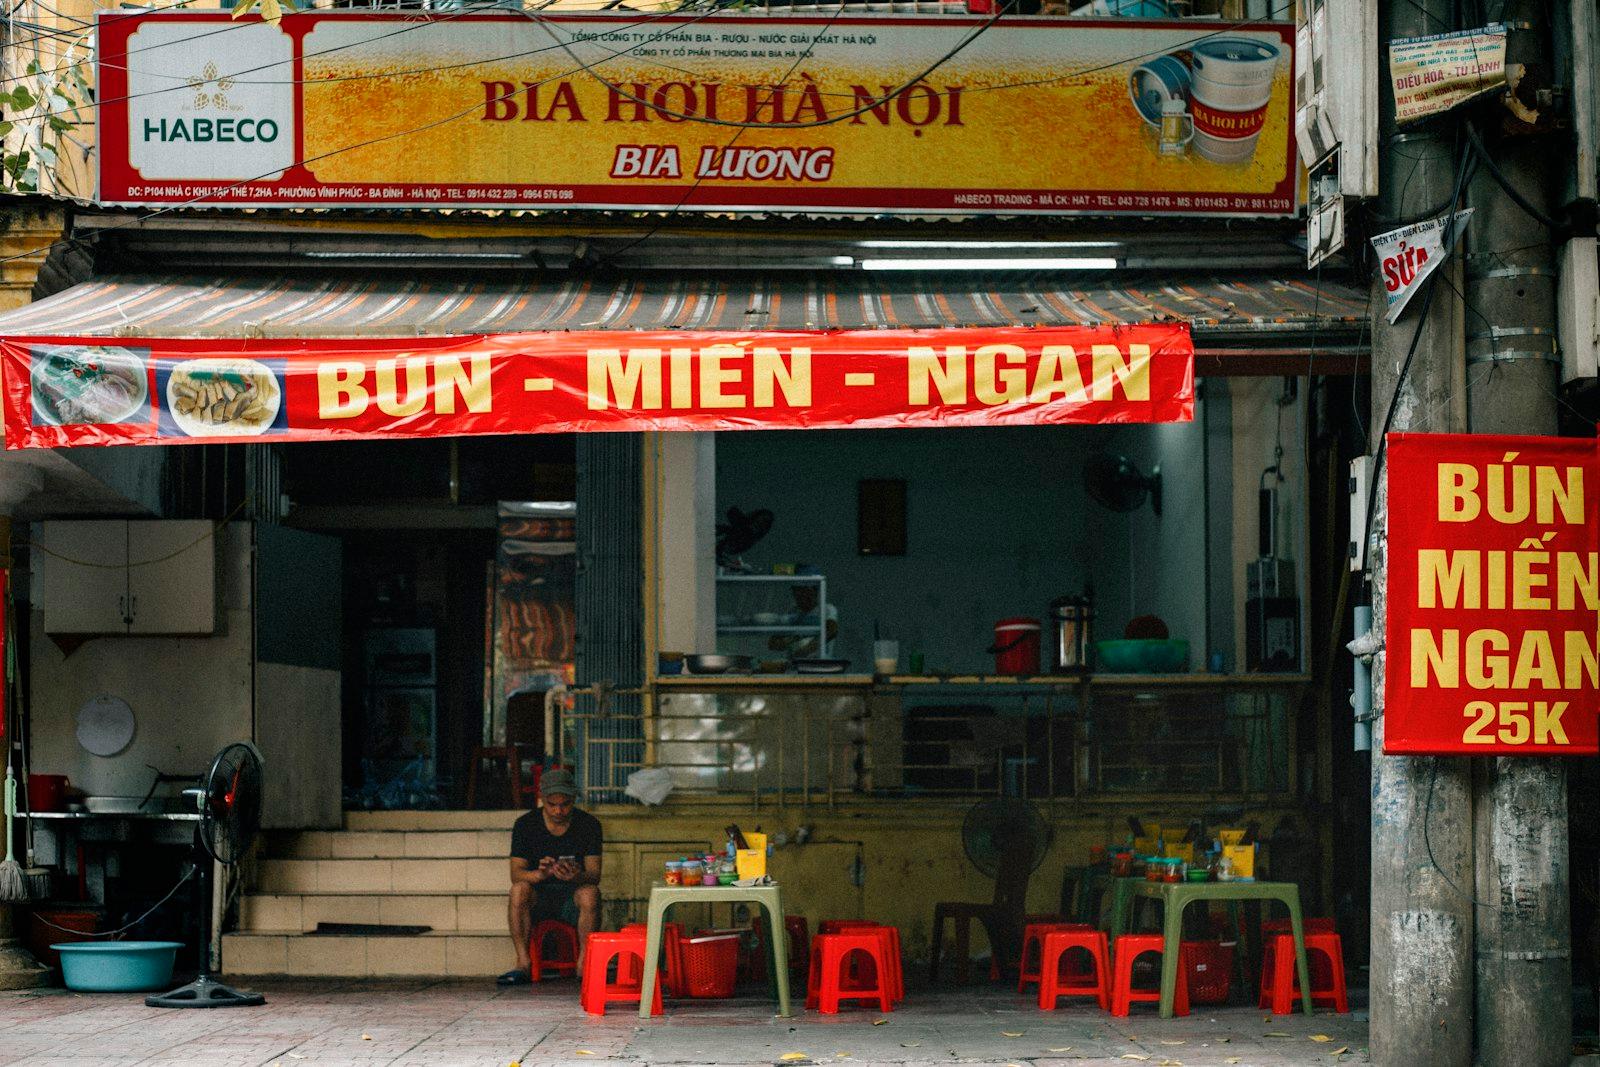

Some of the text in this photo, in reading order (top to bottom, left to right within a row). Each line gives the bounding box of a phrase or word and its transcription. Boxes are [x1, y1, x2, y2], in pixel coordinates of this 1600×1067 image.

[696, 34, 711, 42] BIA
[843, 33, 856, 44] HÀ
[860, 34, 876, 45] NỘI
[480, 72, 966, 138] BIA HƠI HÀ NỘI
[144, 118, 278, 143] HABECO
[612, 147, 832, 180] BIA LƯƠNG
[128, 187, 143, 196] ĐC:
[145, 187, 164, 197] P104
[165, 185, 183, 197] NHÀ
[185, 188, 191, 197] C
[193, 187, 211, 197] KHU
[339, 186, 363, 197] PHÚC
[369, 188, 382, 198] BA
[412, 187, 425, 198] HÀ
[426, 188, 442, 200] NỘI
[447, 189, 465, 199] TEL:
[954, 194, 991, 205] HABECO
[994, 194, 1032, 205] TRADING
[1055, 195, 1070, 205] CK:
[1072, 196, 1090, 205] HAT
[1097, 196, 1116, 206] TEL:
[1383, 241, 1428, 292] SỬA
[316, 352, 492, 420] BÚN
[587, 340, 812, 410] MIẾN
[908, 344, 1151, 406] NGAN
[1437, 452, 1585, 524] BÚN
[1418, 532, 1599, 610] MIẾN
[1410, 628, 1599, 689] NGAN
[1462, 701, 1570, 745] 25K
